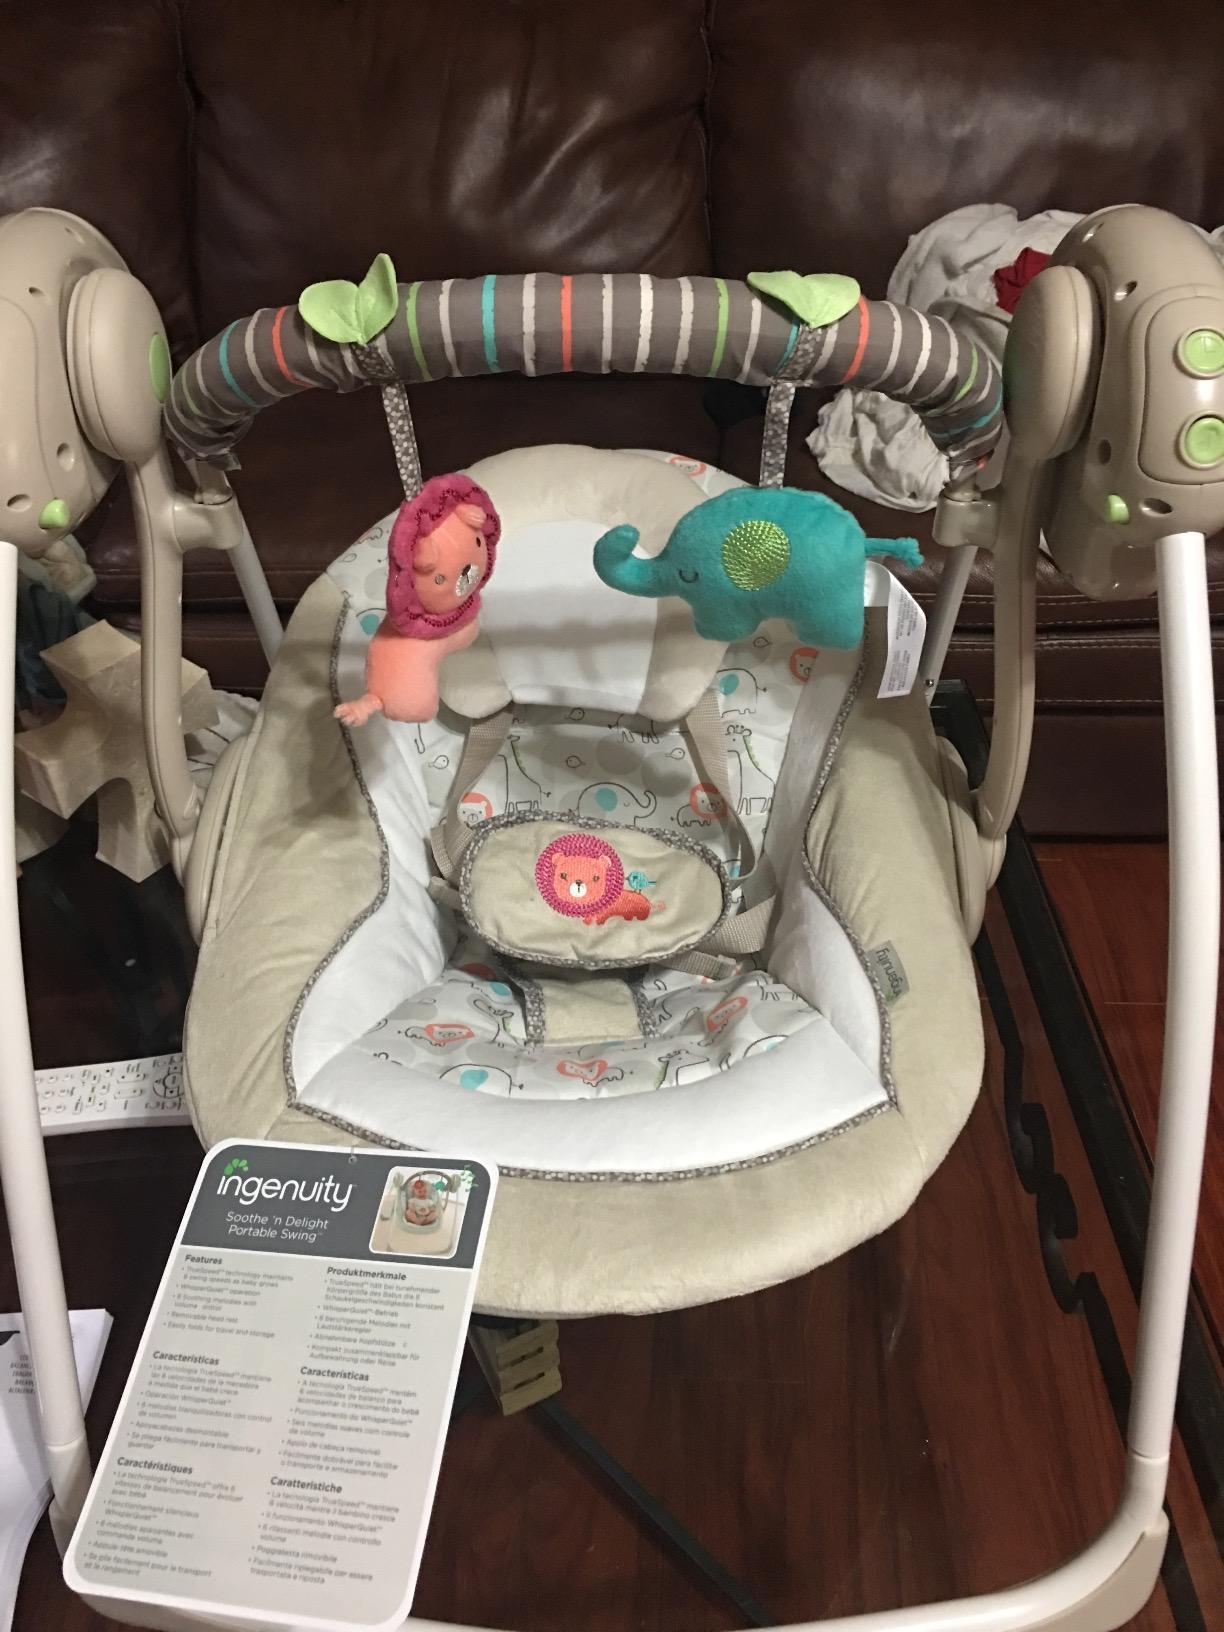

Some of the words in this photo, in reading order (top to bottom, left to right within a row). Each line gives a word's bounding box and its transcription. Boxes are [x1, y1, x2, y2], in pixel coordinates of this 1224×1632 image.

[217, 1175, 353, 1212] ingenuity
[226, 1211, 268, 1225] Soothe
[285, 1217, 329, 1230] Delight
[228, 1224, 278, 1238] Portable
[185, 1255, 222, 1264] Features
[327, 1267, 406, 1280] Produktmerkmale
[270, 1477, 342, 1492] Caratteristiche
